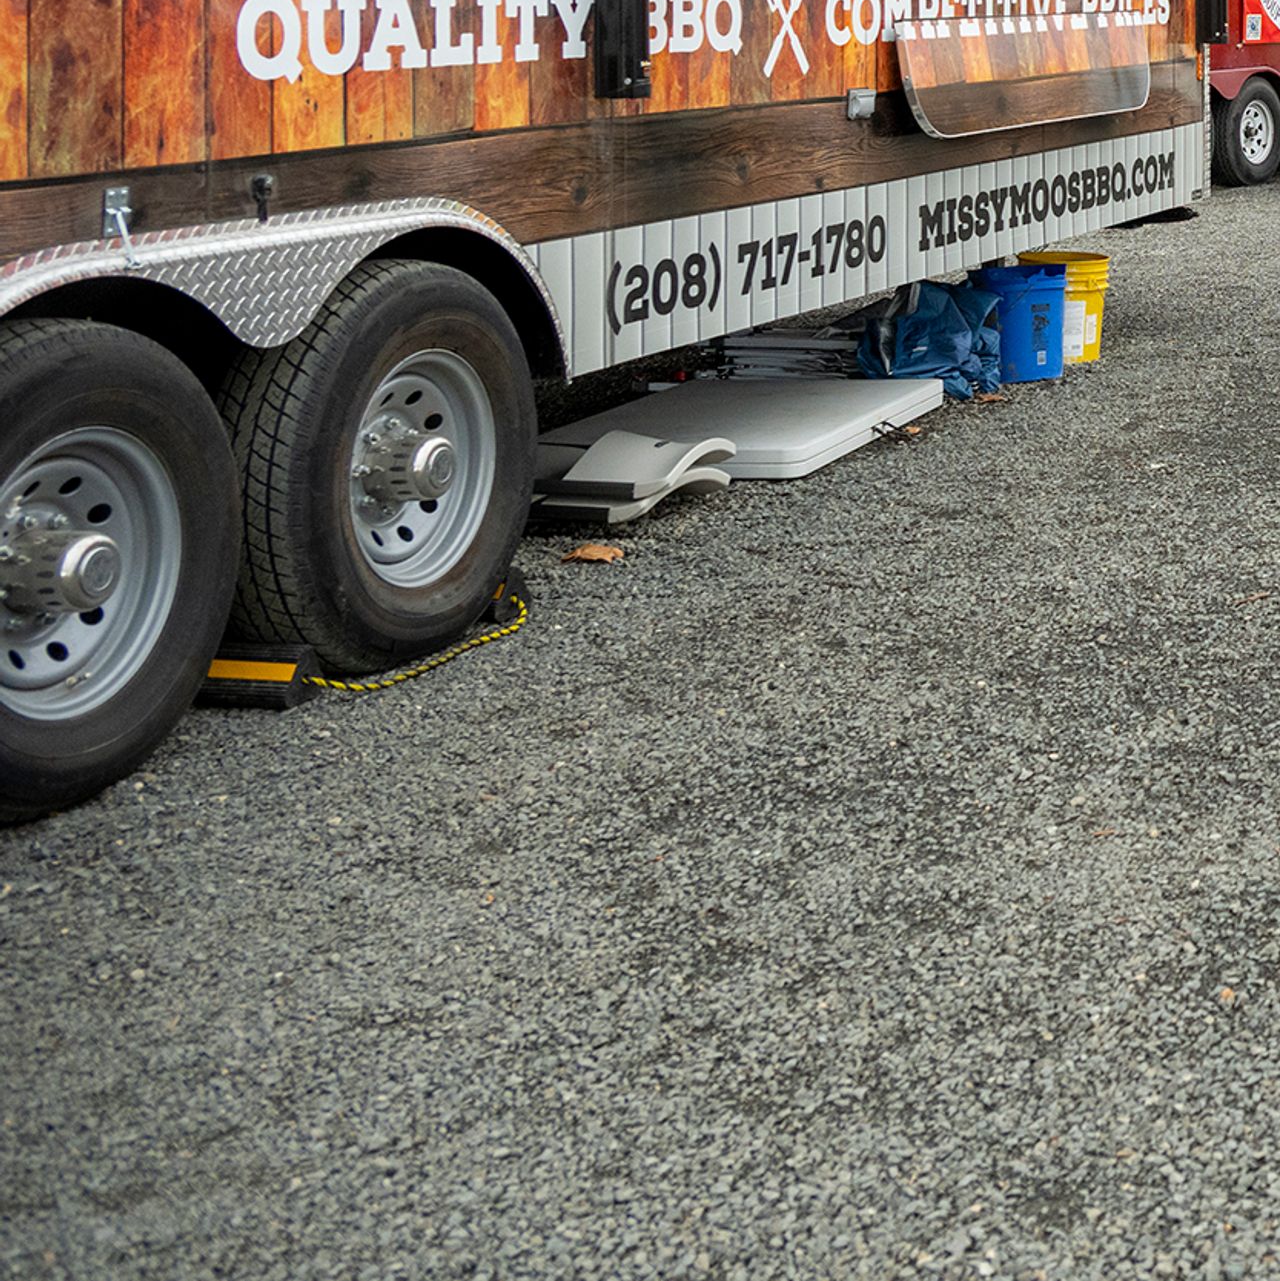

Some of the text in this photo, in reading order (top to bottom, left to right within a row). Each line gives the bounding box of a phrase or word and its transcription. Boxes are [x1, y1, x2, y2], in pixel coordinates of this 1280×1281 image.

[607, 151, 1175, 336] (208) 717-1780 MISSYMOOSBBQ.COM
